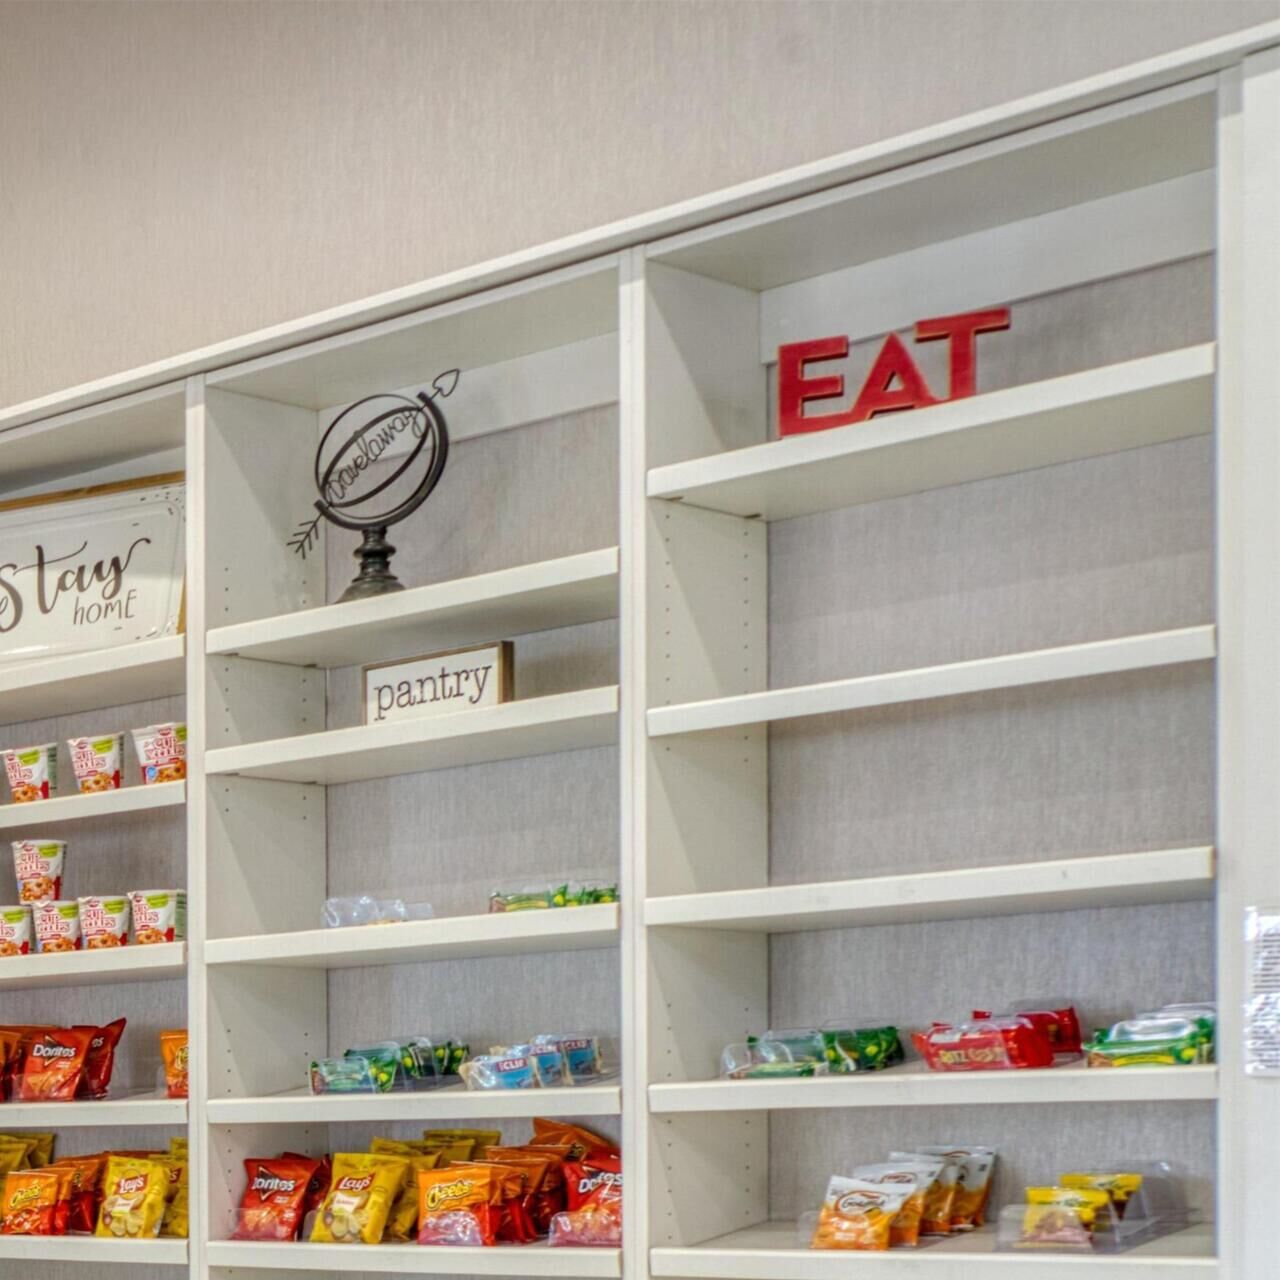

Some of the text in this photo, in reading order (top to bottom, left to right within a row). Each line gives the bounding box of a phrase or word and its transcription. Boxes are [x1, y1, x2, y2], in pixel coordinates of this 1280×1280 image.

[778, 305, 1012, 440] EAT
[373, 665, 492, 722] pantry
[32, 1044, 76, 1058] Doritos
